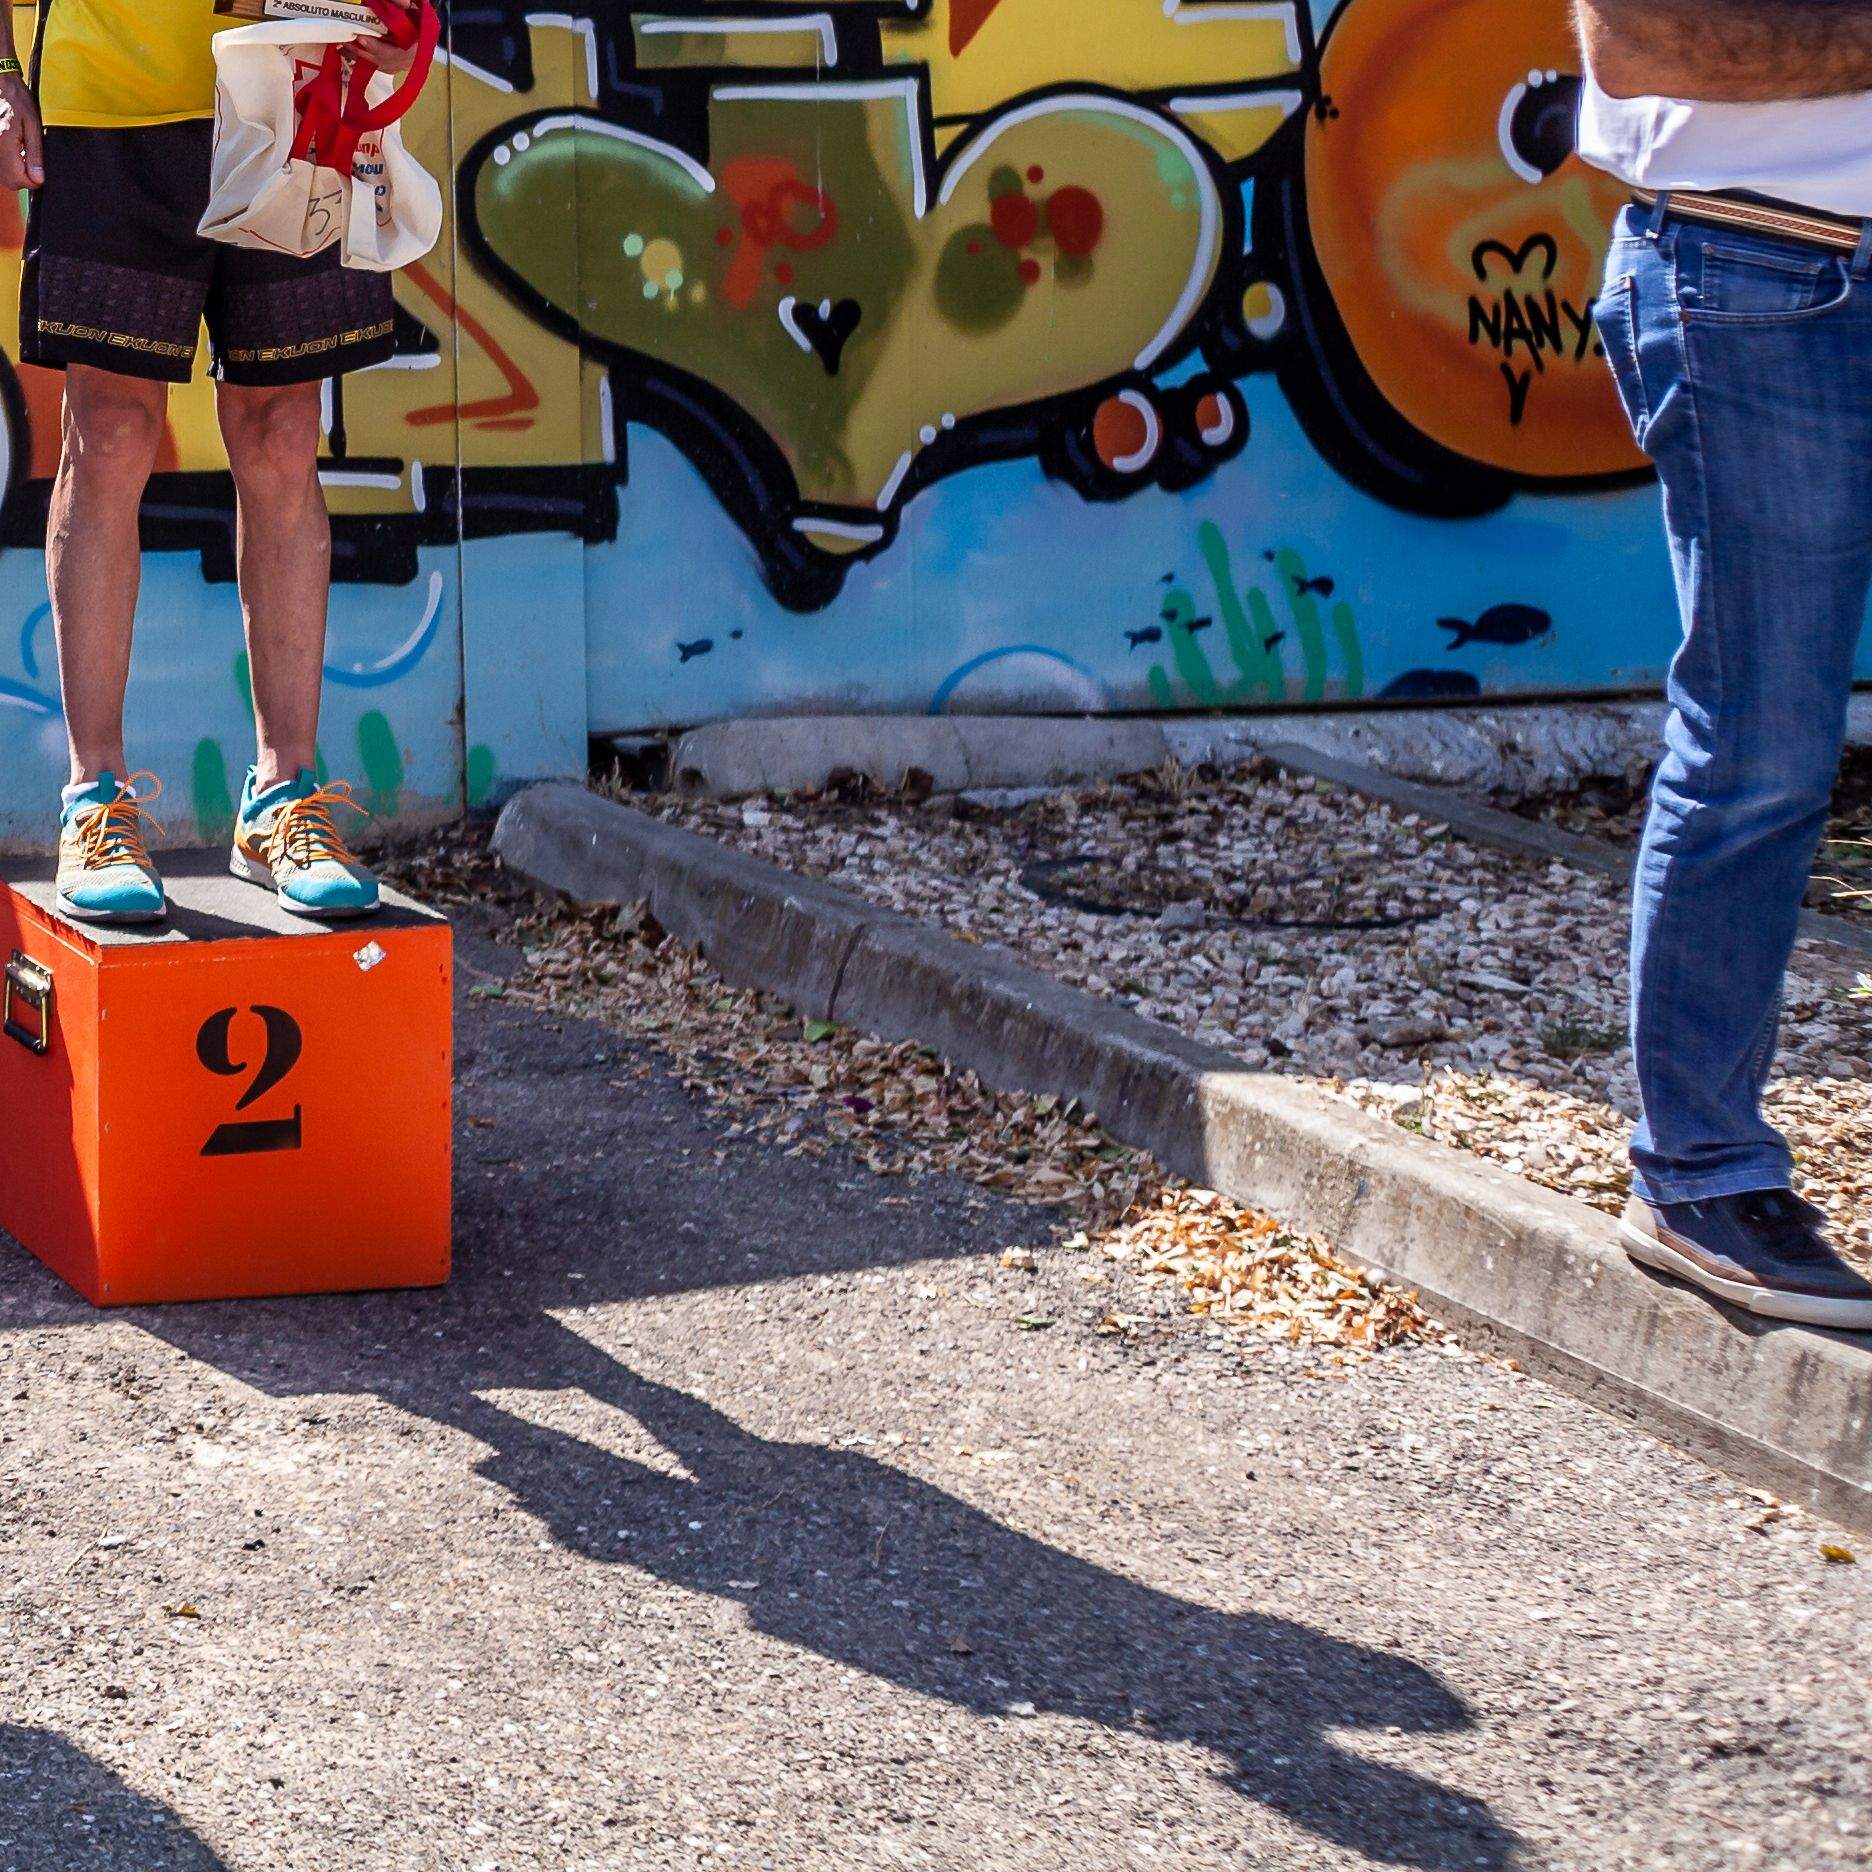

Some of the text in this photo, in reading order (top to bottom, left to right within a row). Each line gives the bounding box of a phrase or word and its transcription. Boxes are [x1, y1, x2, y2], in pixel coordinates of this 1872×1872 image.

[283, 1, 381, 26] ABSOLUTO MASCULINO
[195, 1004, 303, 1157] 2
